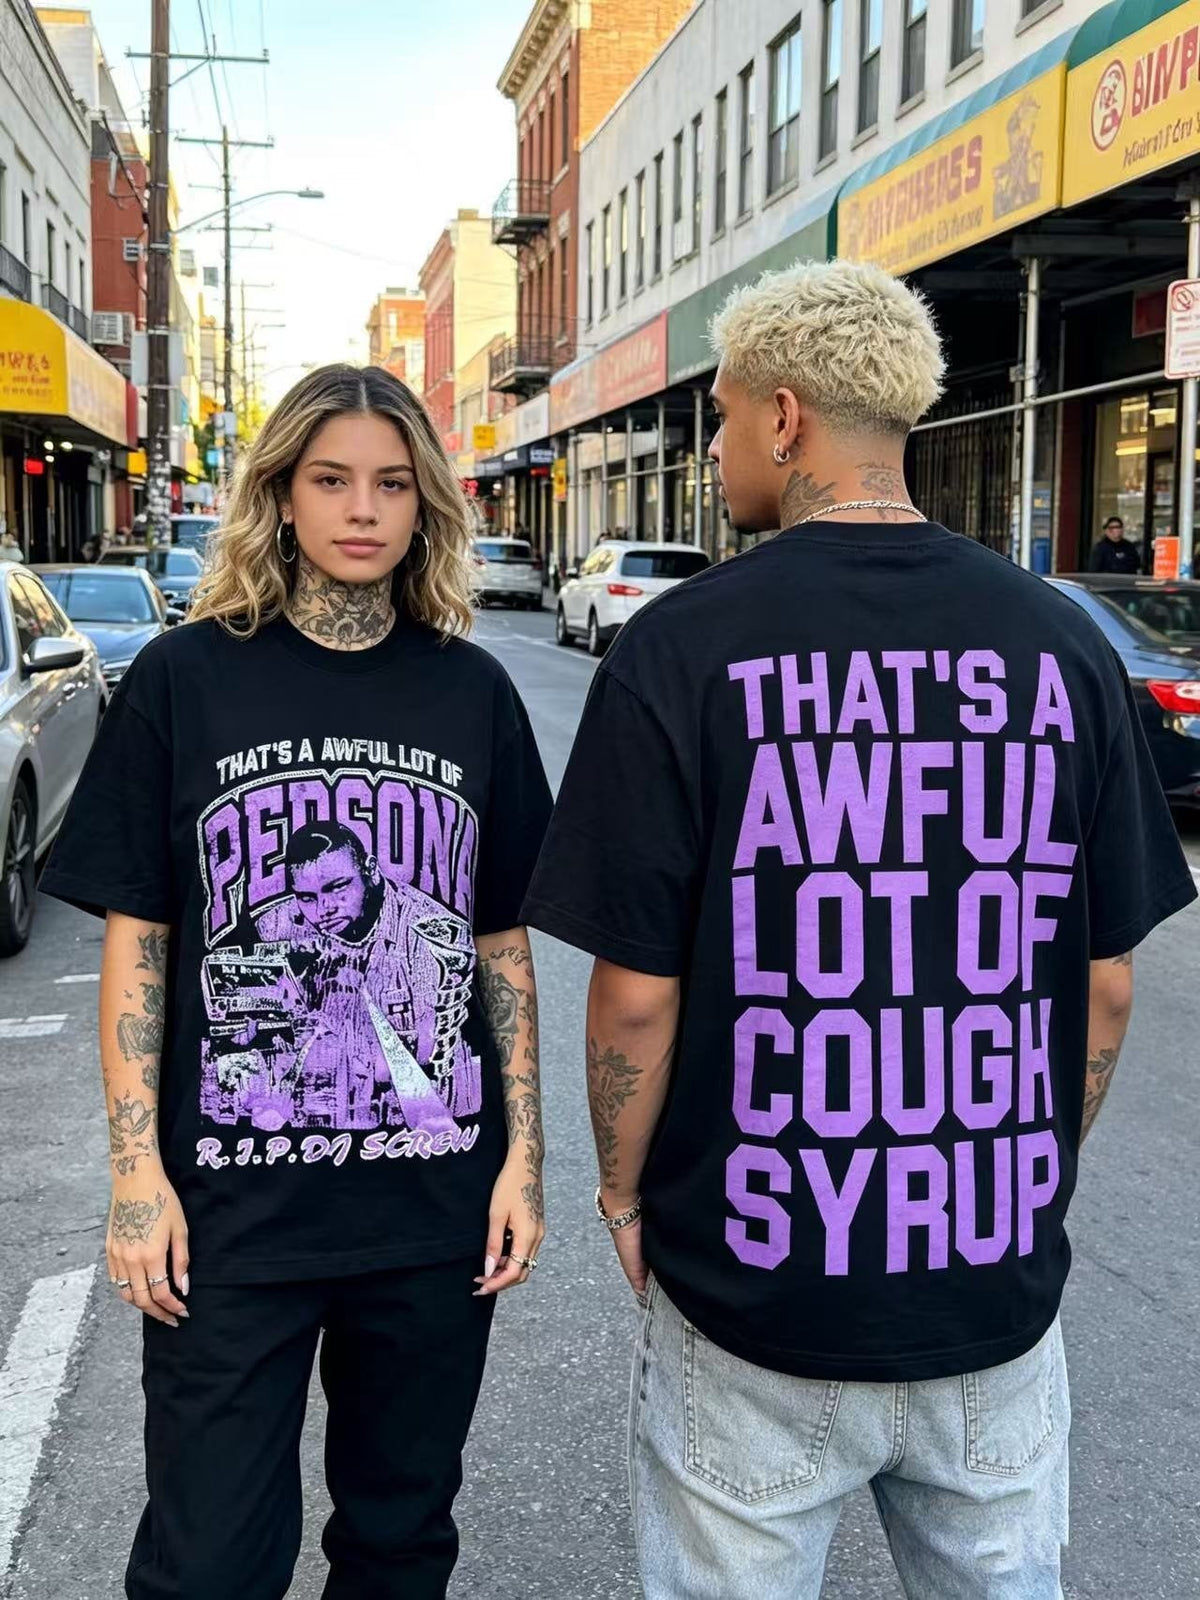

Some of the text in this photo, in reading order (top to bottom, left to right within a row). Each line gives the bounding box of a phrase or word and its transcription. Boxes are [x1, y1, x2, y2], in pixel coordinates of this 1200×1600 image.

[1131, 25, 1200, 118] BINP
[728, 650, 1076, 743] THAT'S A
[216, 737, 464, 787] THAT'S A AWFUL LOT OF
[733, 741, 1078, 870] AWFUL
[732, 871, 1073, 999] LOT OF
[732, 999, 1054, 1138] COUGH
[360, 1124, 480, 1160] SCREW
[725, 1129, 1060, 1276] SYRUP
